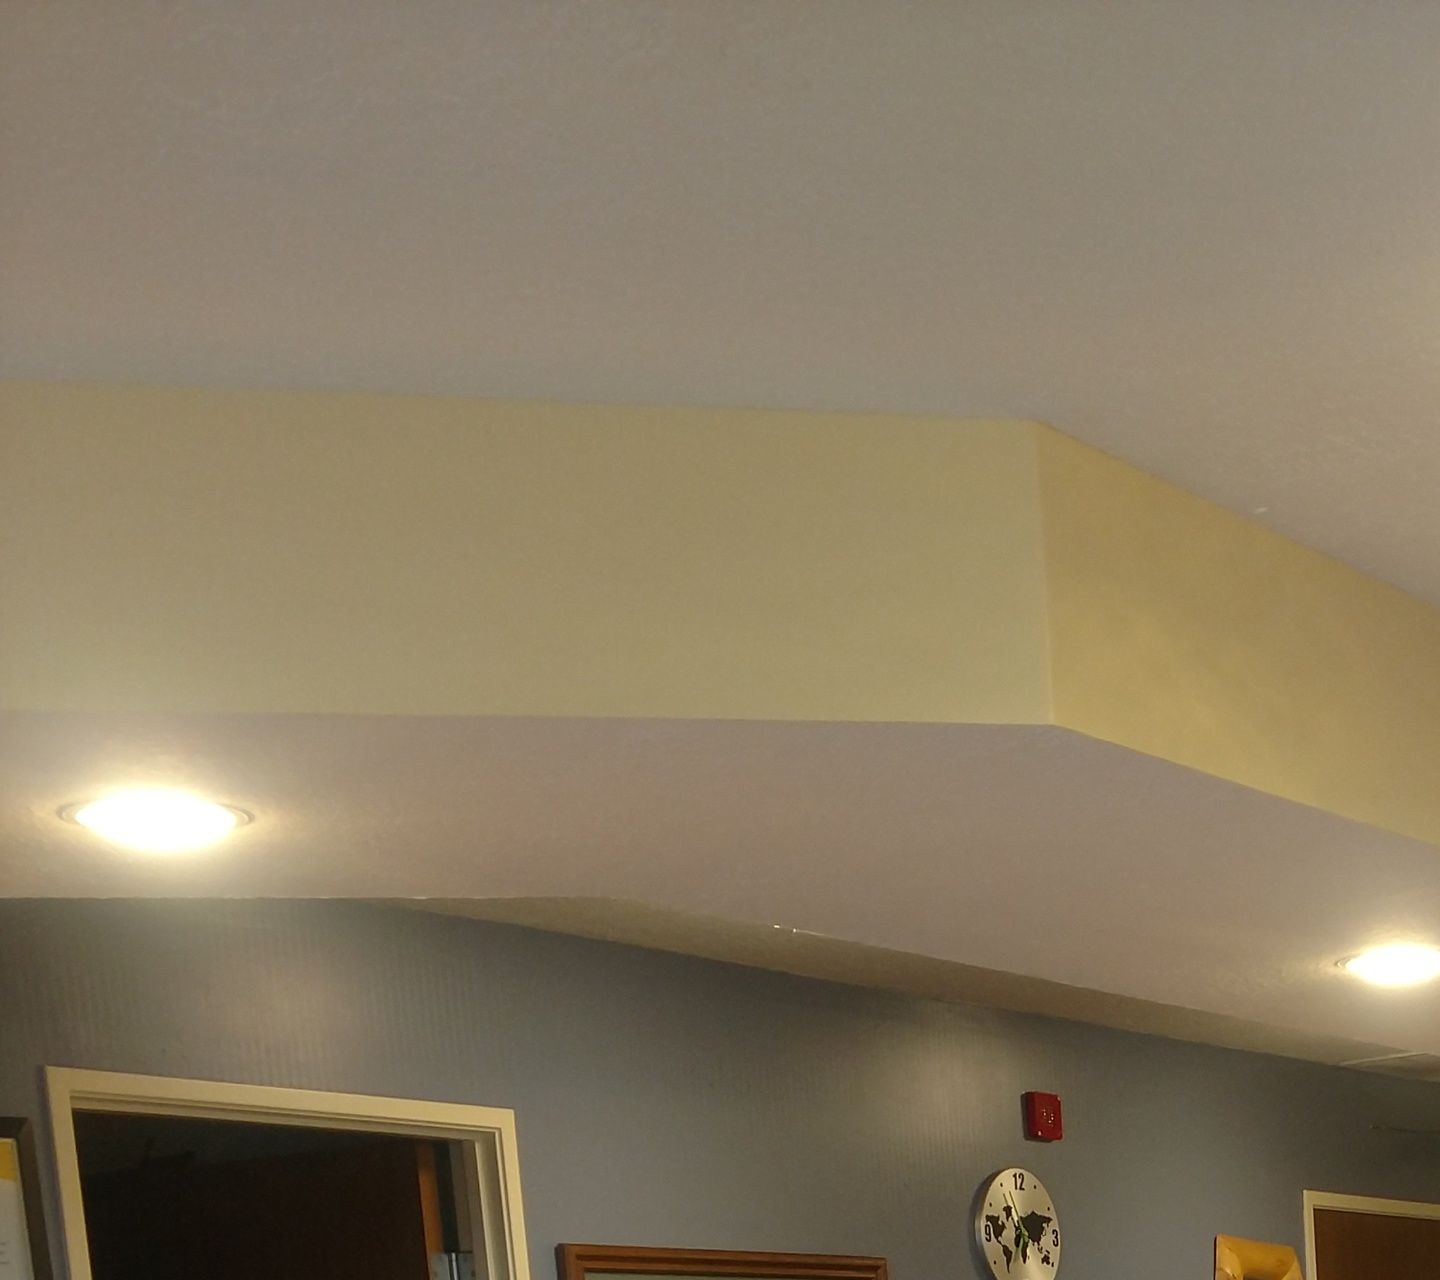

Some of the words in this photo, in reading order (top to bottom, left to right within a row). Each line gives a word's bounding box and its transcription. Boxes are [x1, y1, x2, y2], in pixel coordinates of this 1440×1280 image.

[1012, 1172, 1025, 1191] 12
[984, 1223, 992, 1242] 9
[1051, 1229, 1059, 1247] 3
